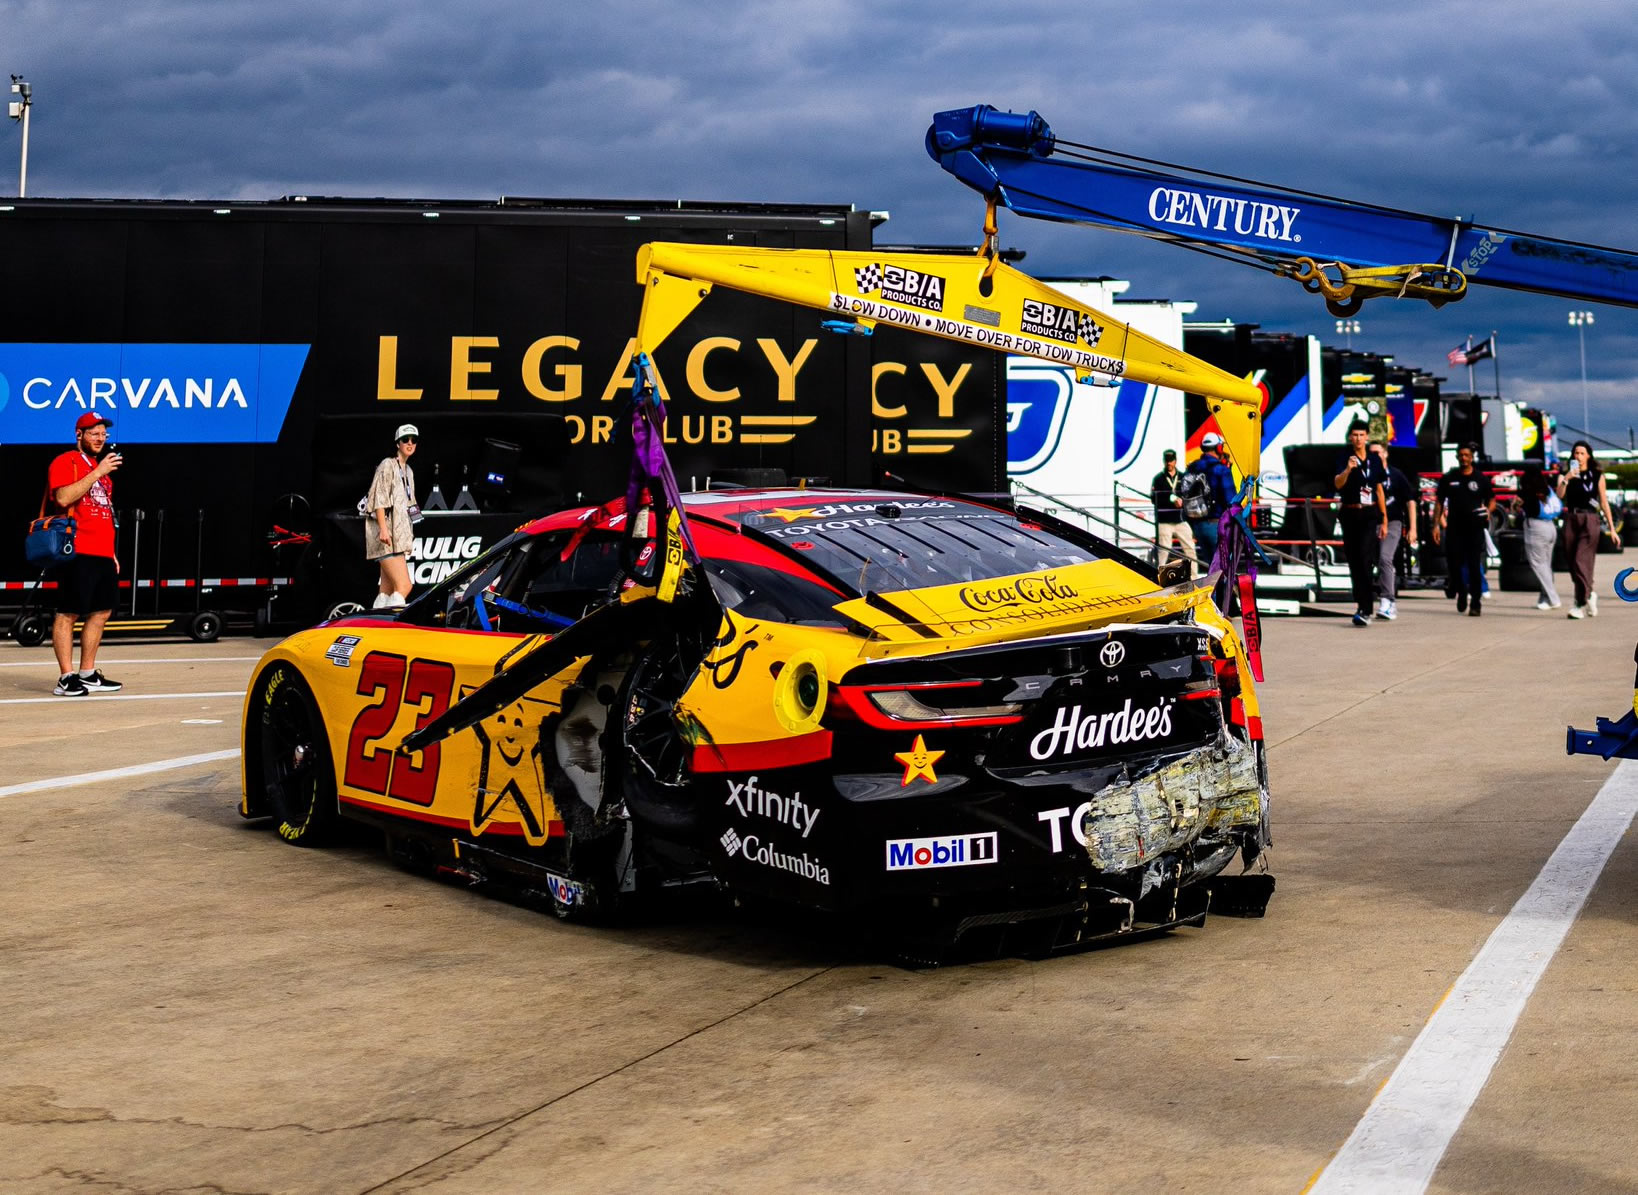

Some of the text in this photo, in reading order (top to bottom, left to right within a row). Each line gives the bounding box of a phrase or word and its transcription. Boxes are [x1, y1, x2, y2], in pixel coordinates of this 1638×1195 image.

[1148, 187, 1300, 242] CENTURY
[1469, 240, 1492, 267] STOP
[881, 289, 927, 307] PRODUCTS
[904, 270, 941, 300] B/A
[1021, 321, 1064, 339] PRODUCTS
[1042, 303, 1076, 332] B/A
[834, 294, 1125, 374] SLOW DOWN MOVE OVER FOR TOW TRUCKS
[377, 335, 819, 402] LEGACY
[23, 377, 248, 408] CARVANA
[632, 415, 733, 444] LUB
[764, 518, 888, 538] TOYOTA
[404, 536, 482, 559] AULIG
[265, 669, 285, 705] EAGLE
[1025, 664, 1182, 691] CAMRY
[344, 650, 456, 807] 23
[1030, 696, 1173, 760] Hardee's
[725, 776, 821, 838] xfinity
[741, 835, 830, 885] Columbia
[889, 838, 965, 867] Mobil
